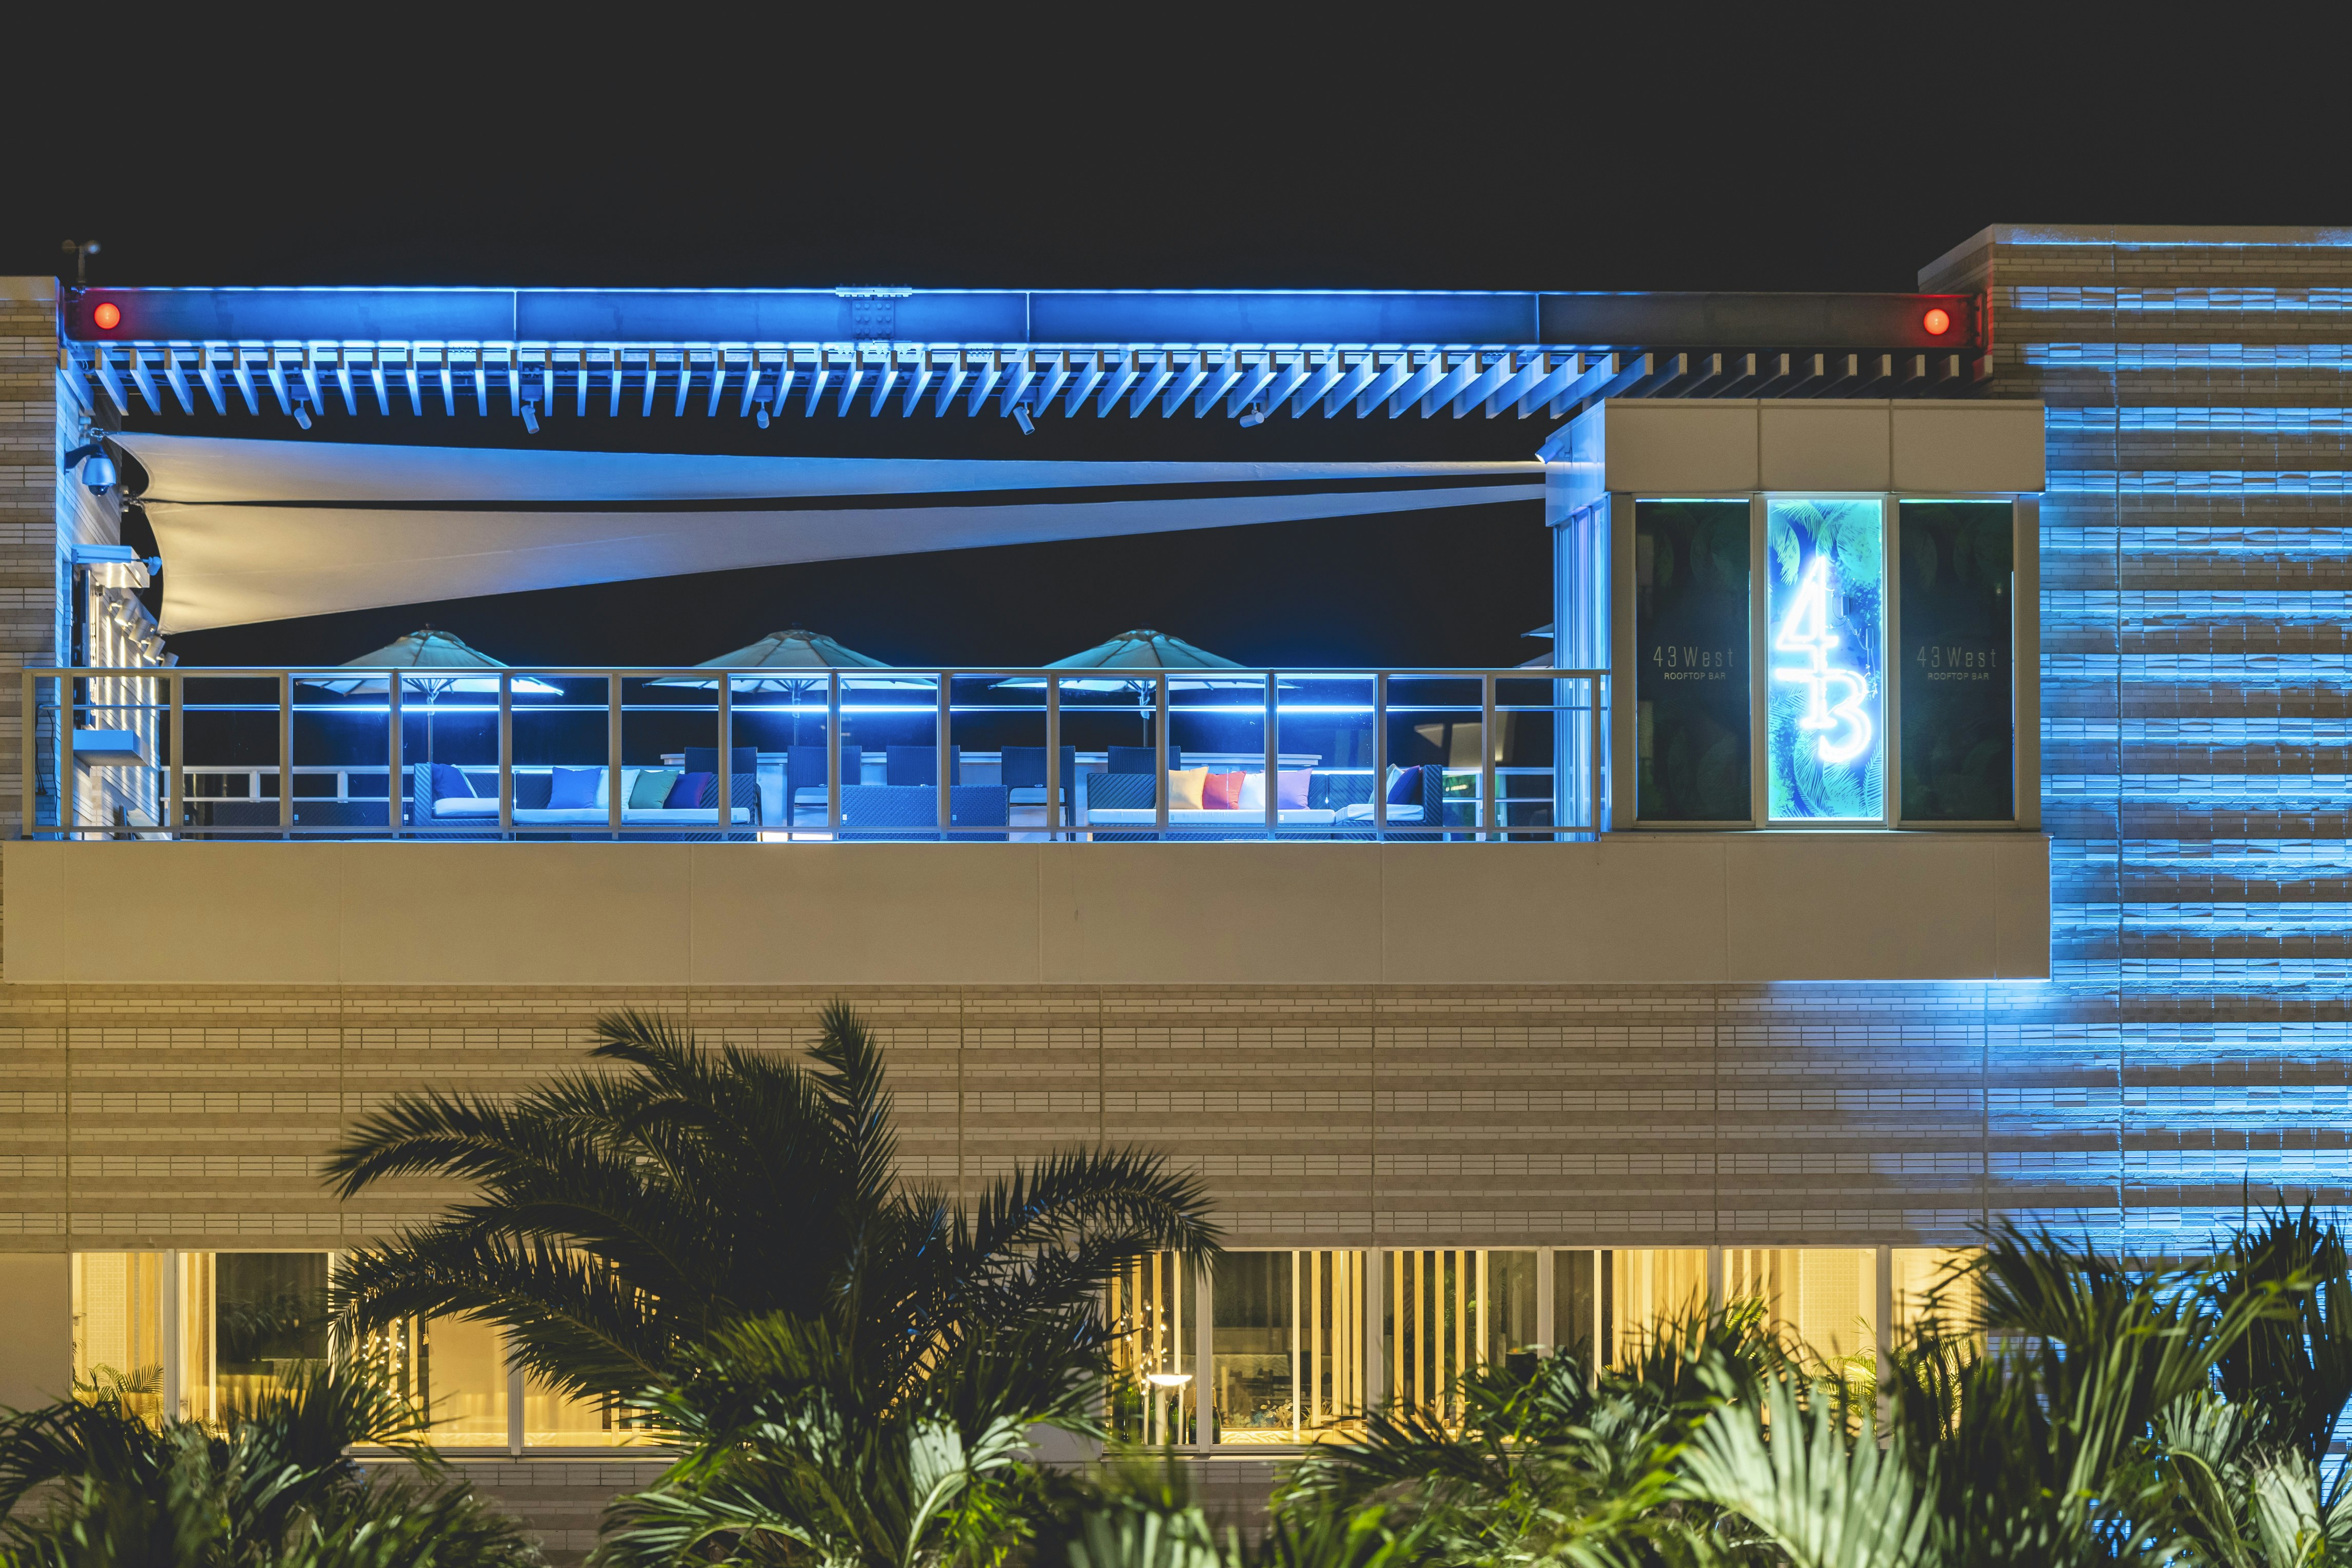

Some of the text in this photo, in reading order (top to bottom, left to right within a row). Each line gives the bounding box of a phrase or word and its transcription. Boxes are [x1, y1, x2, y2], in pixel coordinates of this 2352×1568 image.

[1653, 646, 1733, 667] 43 West
[1917, 646, 1996, 668] 43 West
[1664, 672, 1726, 680] ROOFTOP BAR
[1927, 672, 1990, 681] ROOFTOP BAR
